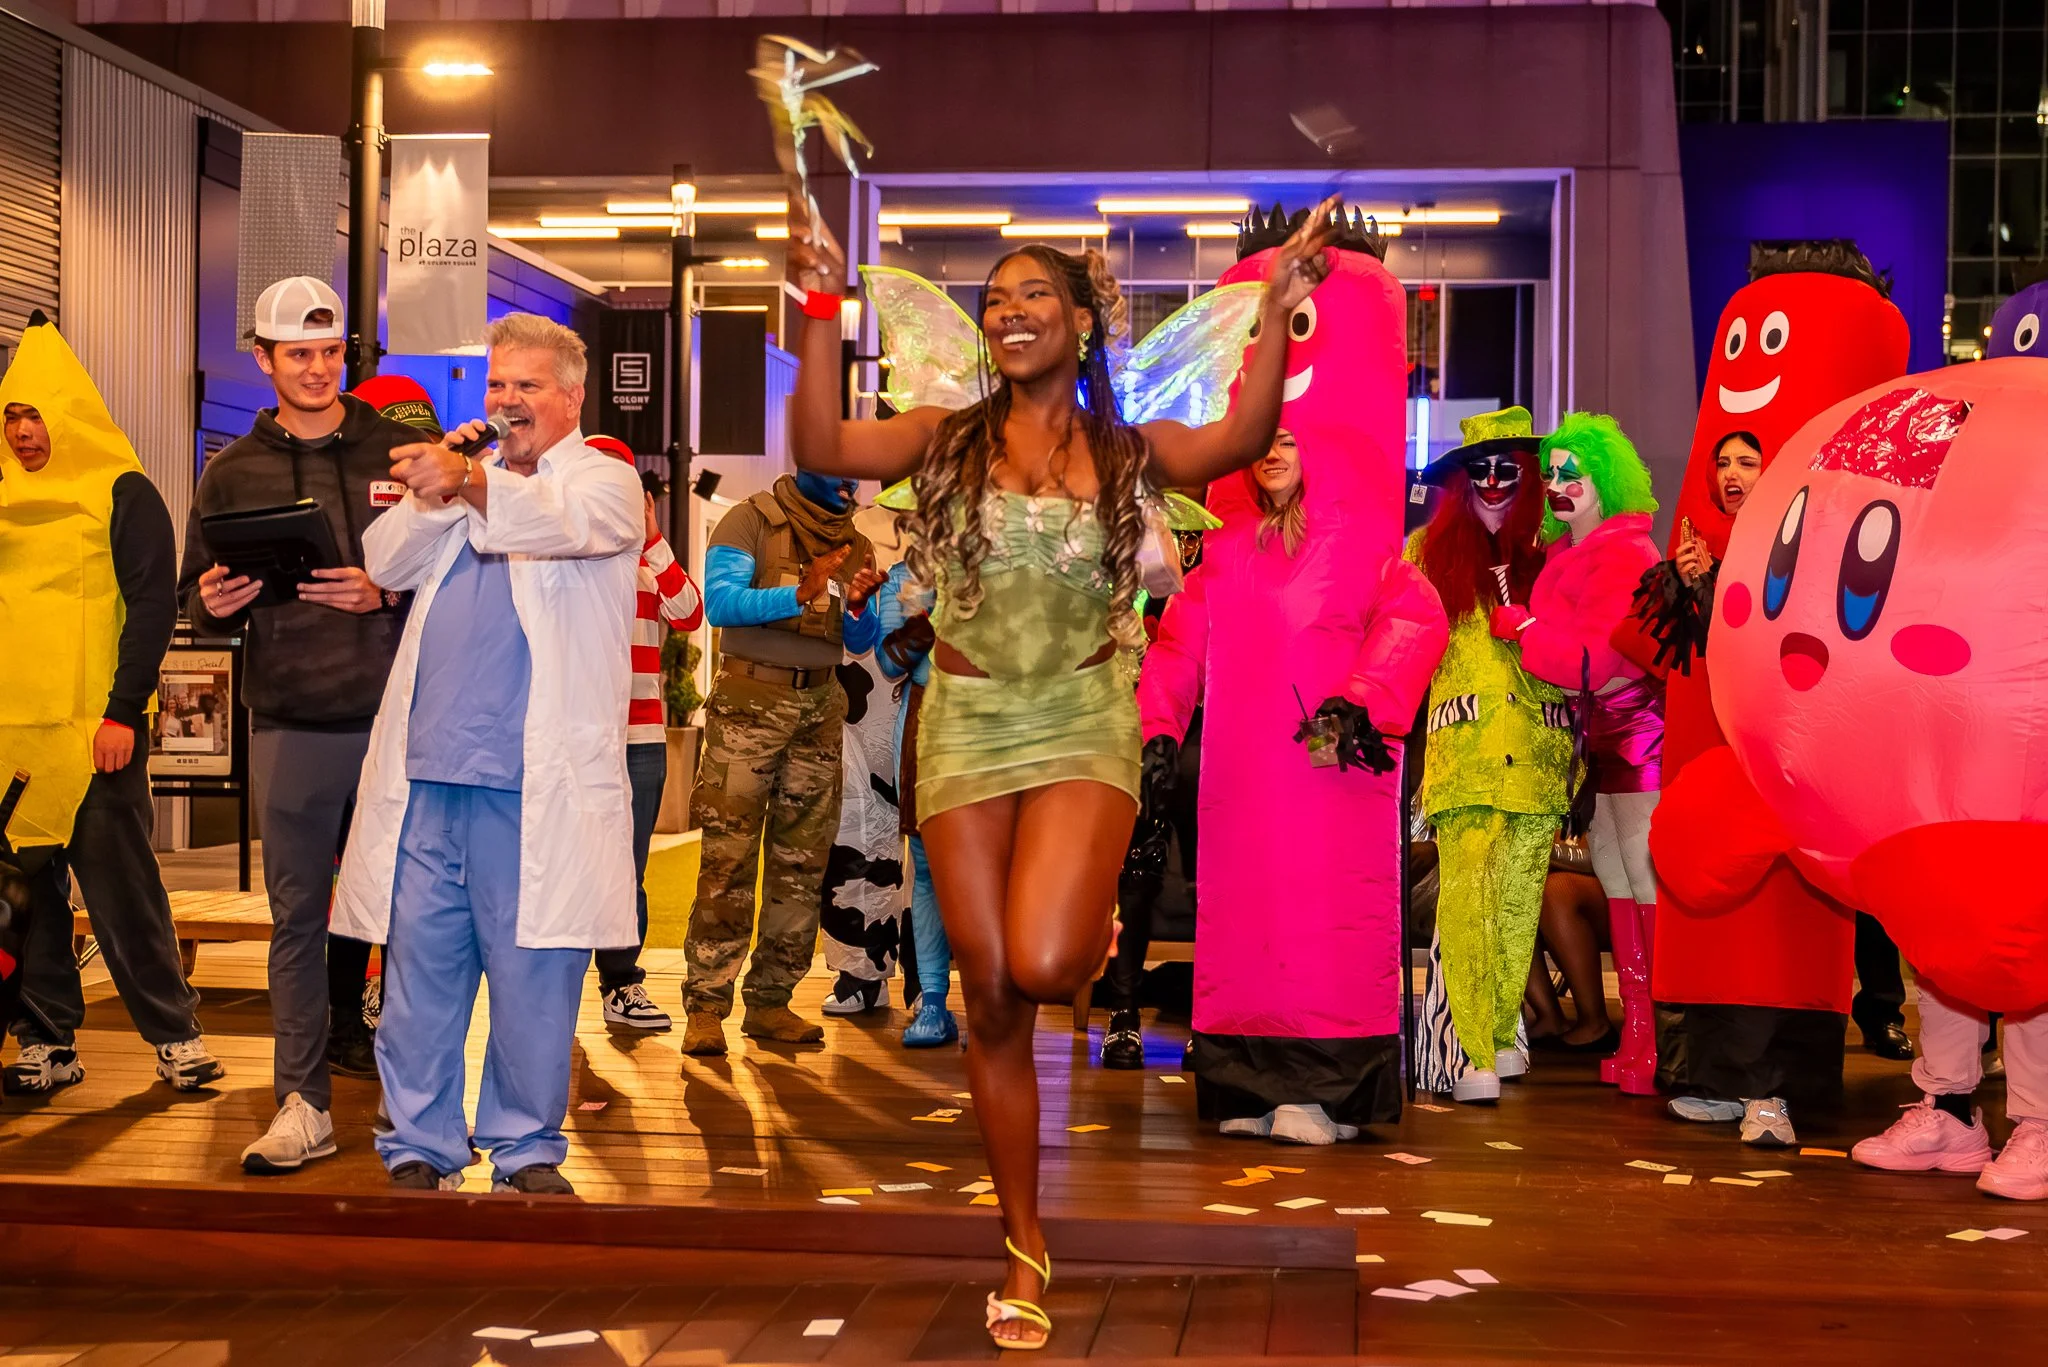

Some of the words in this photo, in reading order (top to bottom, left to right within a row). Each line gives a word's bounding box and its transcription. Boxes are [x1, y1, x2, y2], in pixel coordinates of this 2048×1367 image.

[400, 226, 416, 235] the
[400, 232, 477, 262] plaza
[612, 395, 650, 404] COLONY
